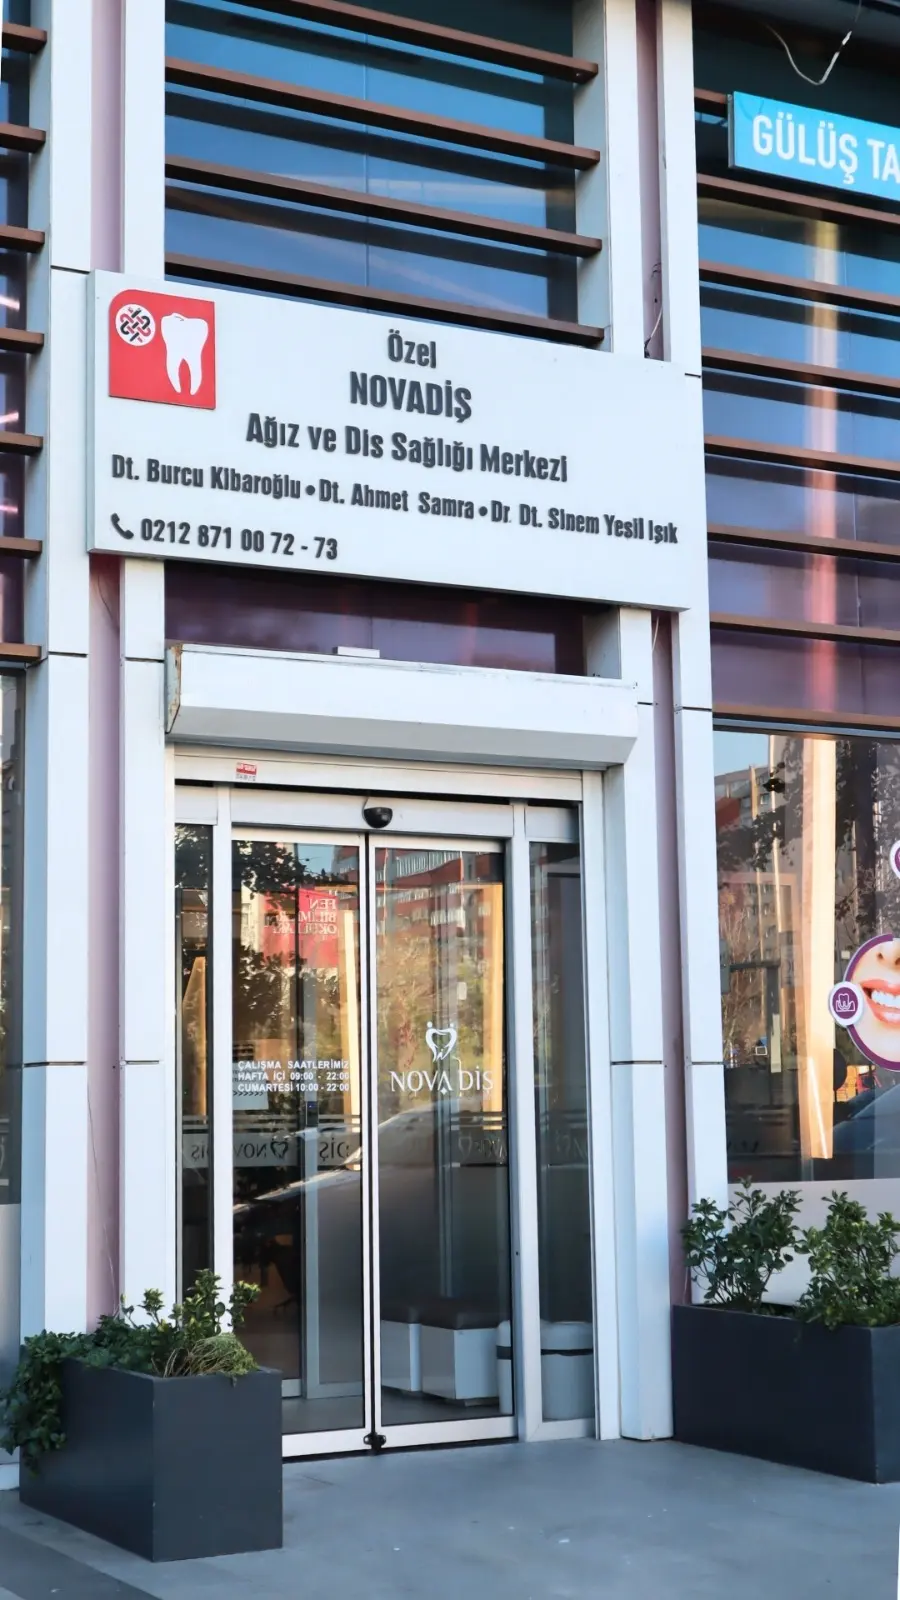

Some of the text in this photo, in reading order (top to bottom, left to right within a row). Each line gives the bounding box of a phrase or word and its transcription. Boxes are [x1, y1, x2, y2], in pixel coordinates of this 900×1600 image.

[752, 111, 859, 184] GÜLÜŞ
[387, 328, 437, 369] Özel
[349, 370, 472, 424] NOVADİŞ
[245, 412, 300, 449] Ağız
[307, 425, 337, 453] ve
[391, 431, 474, 473] Sağlığı
[479, 443, 568, 483] Merkezi
[111, 453, 140, 481] Dt.
[146, 458, 204, 488] Burcu
[318, 478, 346, 505] Dt.
[350, 482, 409, 512] Ahmet
[417, 491, 475, 520] Samra
[518, 503, 543, 528] Dt.
[647, 519, 679, 545] Işık
[140, 517, 191, 545] 0212
[197, 524, 232, 550] 871
[240, 528, 265, 553] 00
[270, 531, 295, 556] 72
[313, 536, 338, 561] 73
[237, 1059, 350, 1071] ÇALIŞMA SAATLERİMİZ
[237, 1072, 269, 1082] HAFTA
[273, 1071, 286, 1083] İÇİ
[290, 1072, 314, 1081] 09:00
[326, 1072, 350, 1081] 22:00
[389, 1069, 454, 1096] NOVA
[237, 1082, 294, 1093] CUMARTESİ
[295, 1083, 319, 1093] 10:00
[326, 1083, 350, 1093] 22:00
